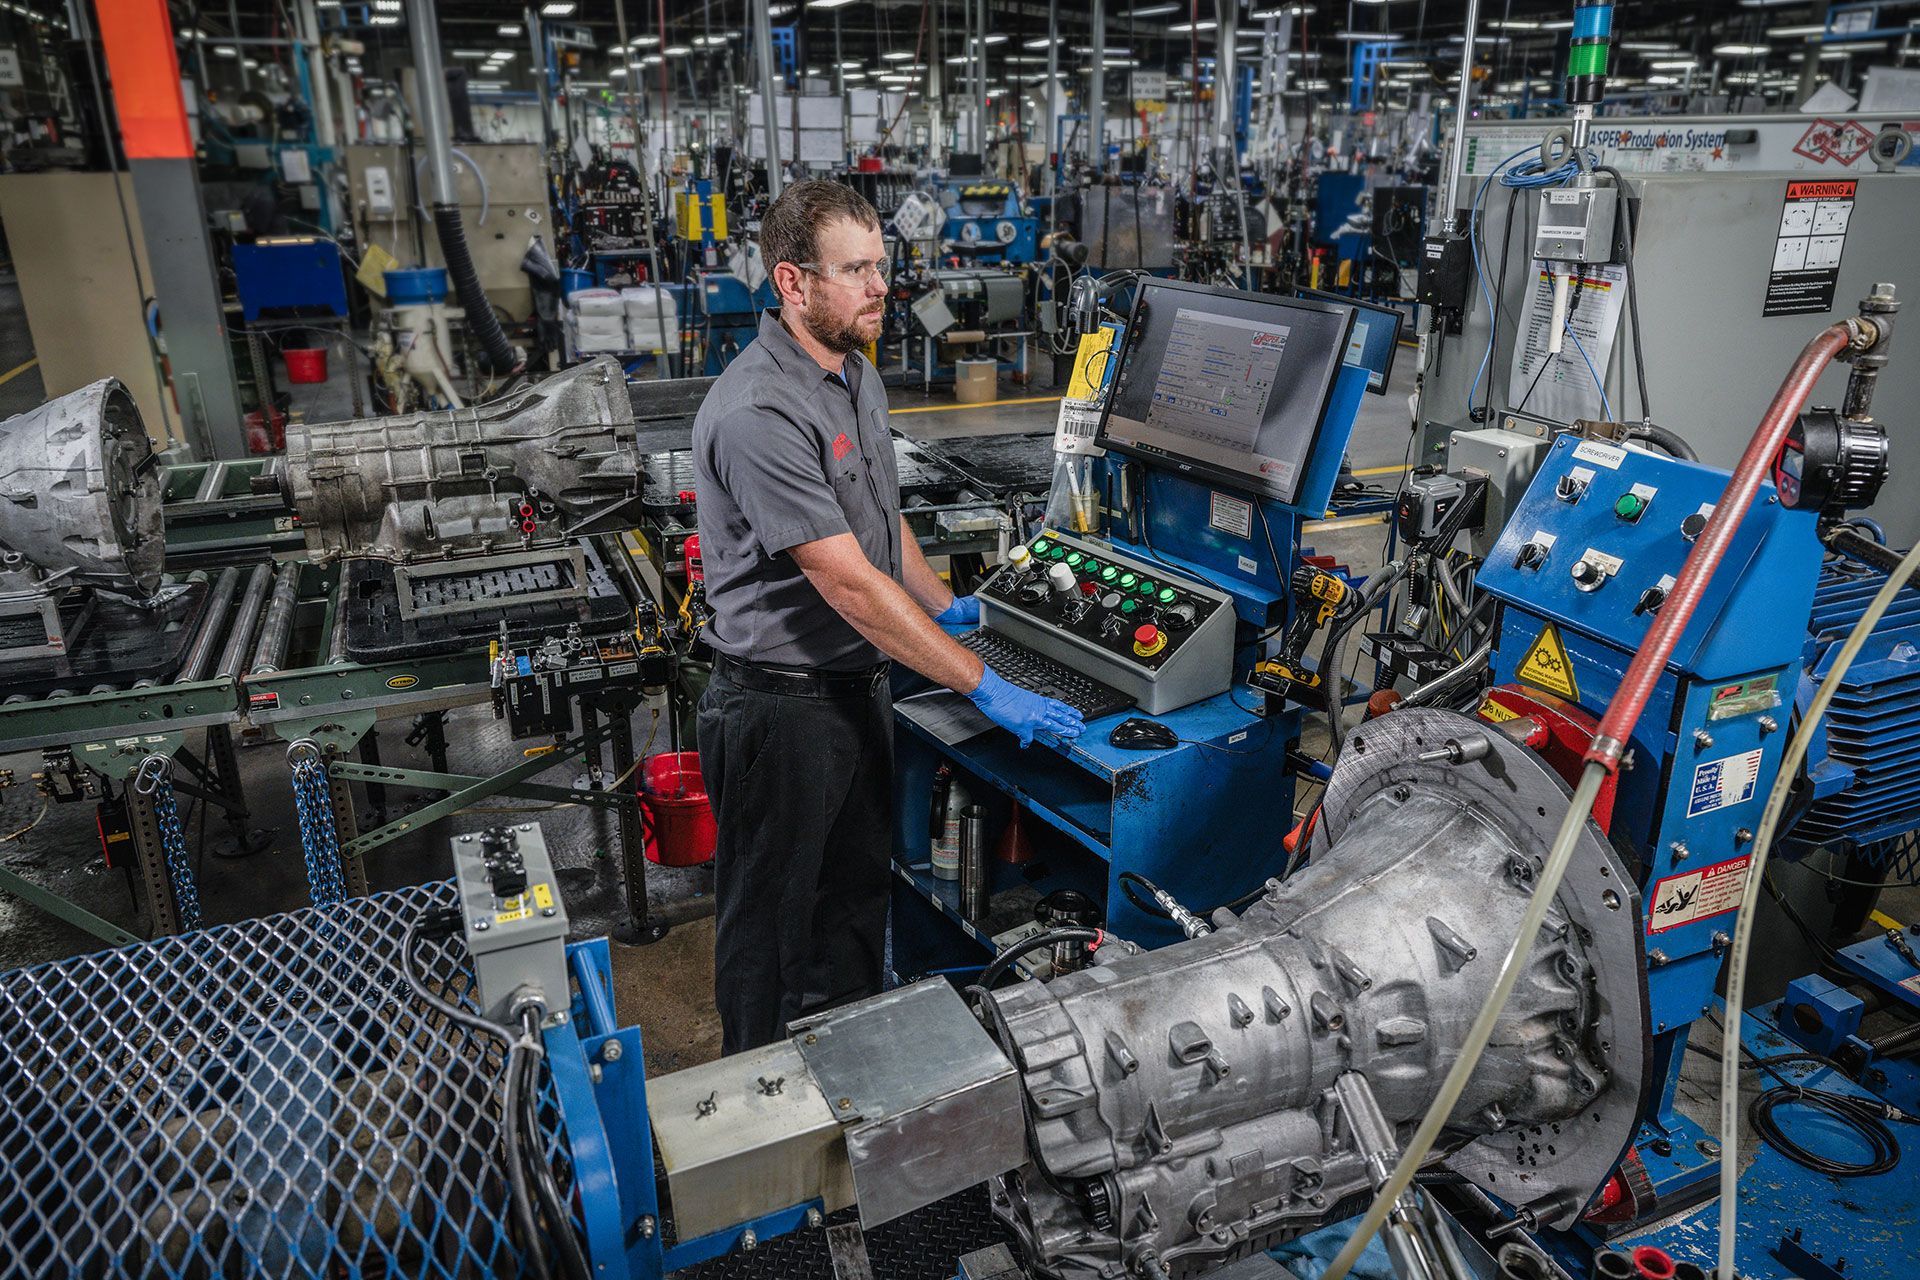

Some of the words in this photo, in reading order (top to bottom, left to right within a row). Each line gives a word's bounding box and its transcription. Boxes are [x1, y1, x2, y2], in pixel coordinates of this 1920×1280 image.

[1589, 131, 1620, 146] ASPER
[1624, 129, 1683, 149] Production
[1685, 129, 1725, 151] System
[1800, 184, 1845, 196] WARNING
[1579, 446, 1620, 463] SCREWDRIVER
[1179, 463, 1191, 471] acer
[1696, 775, 1710, 786] Made
[1717, 860, 1747, 875] DANGER
